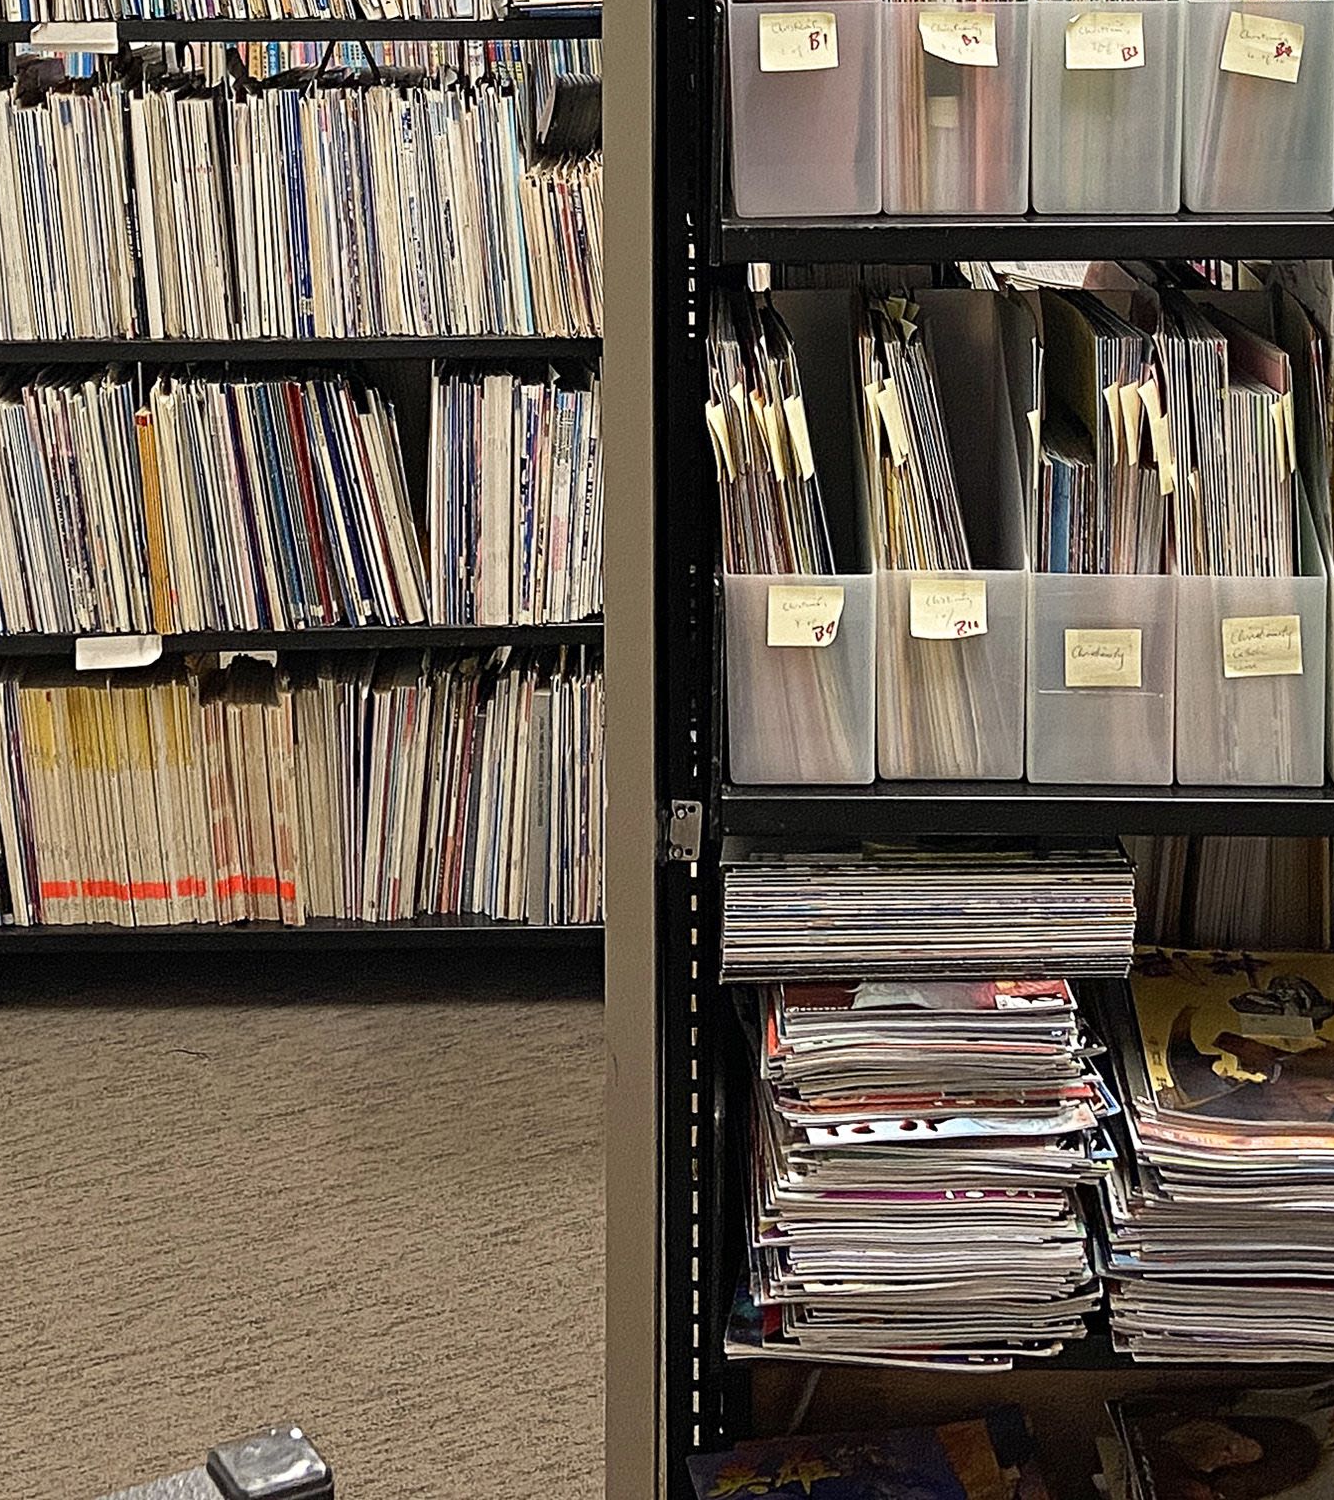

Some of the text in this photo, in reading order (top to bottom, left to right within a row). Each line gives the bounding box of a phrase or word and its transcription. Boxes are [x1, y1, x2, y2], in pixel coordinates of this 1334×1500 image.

[809, 31, 828, 51] B1
[812, 621, 835, 642] B9
[1071, 644, 1125, 670] Christianity
